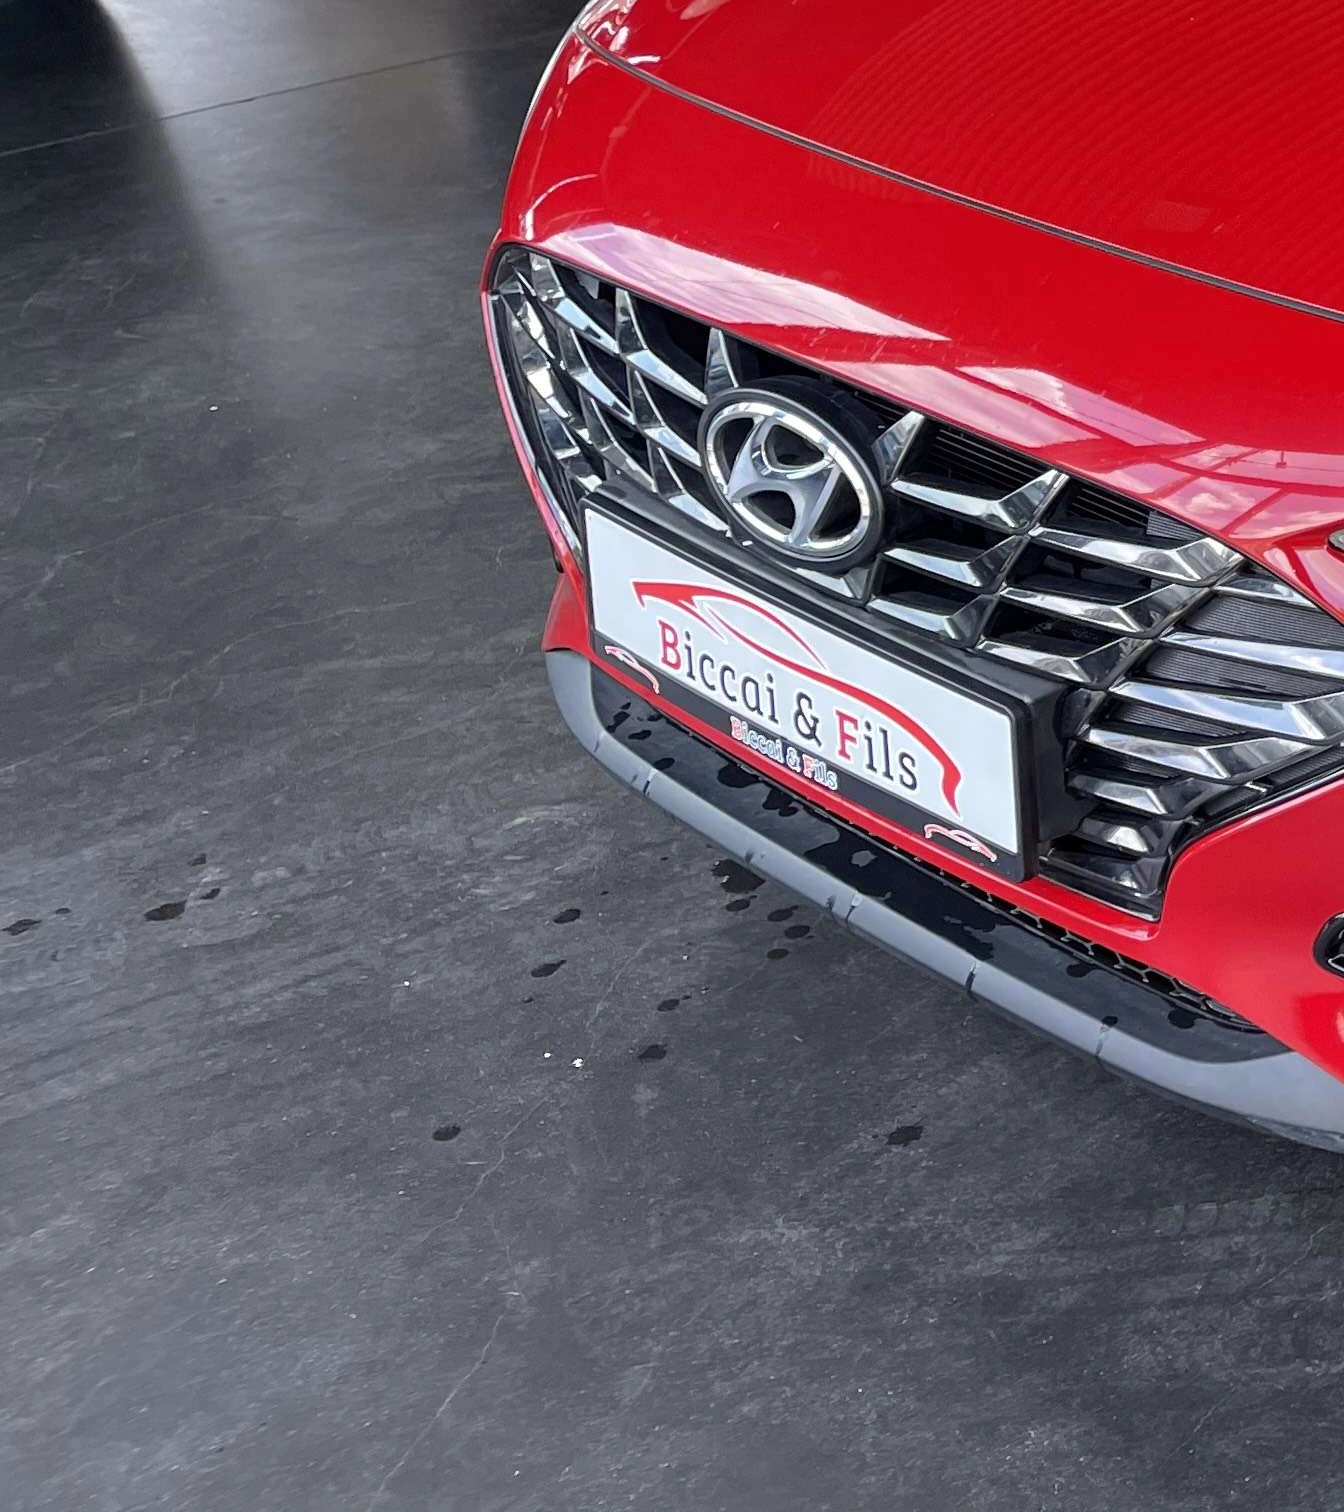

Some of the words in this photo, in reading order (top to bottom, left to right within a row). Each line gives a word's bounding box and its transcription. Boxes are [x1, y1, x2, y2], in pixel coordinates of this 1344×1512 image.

[657, 619, 780, 723] Biccai
[793, 691, 822, 748] &
[834, 709, 919, 791] Fils
[730, 715, 786, 765] Biccai
[786, 746, 802, 774] &
[802, 752, 838, 791] Fils
